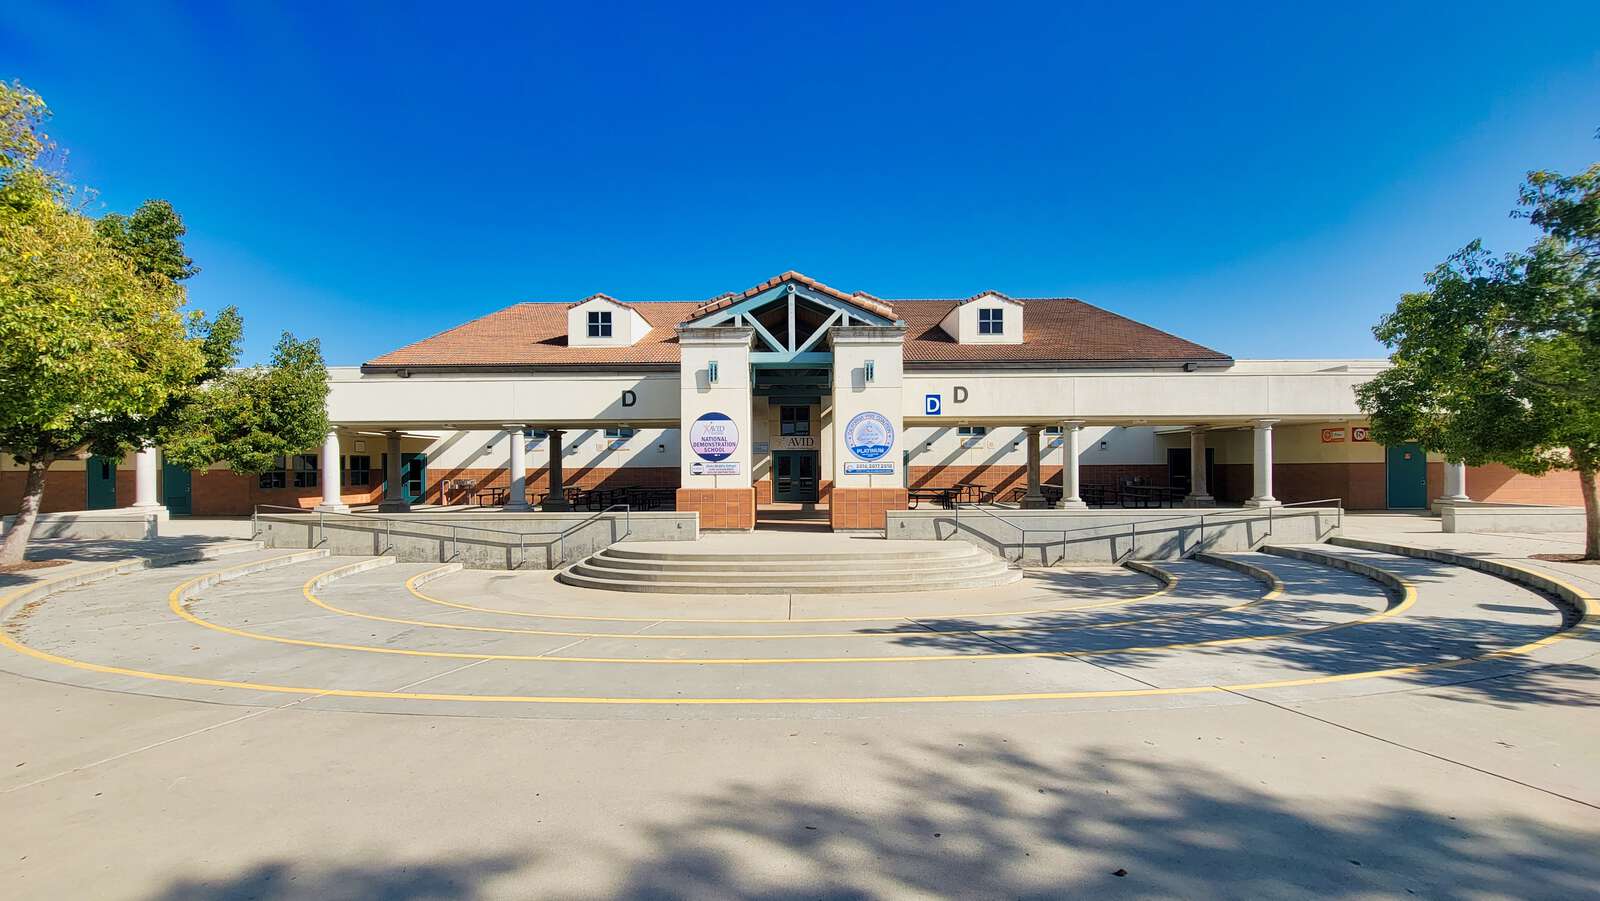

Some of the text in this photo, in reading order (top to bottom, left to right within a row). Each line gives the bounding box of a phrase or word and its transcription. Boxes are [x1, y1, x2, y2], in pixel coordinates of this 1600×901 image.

[622, 390, 637, 407] D
[953, 386, 969, 403] D
[927, 397, 940, 412] D
[789, 437, 814, 446] AVID
